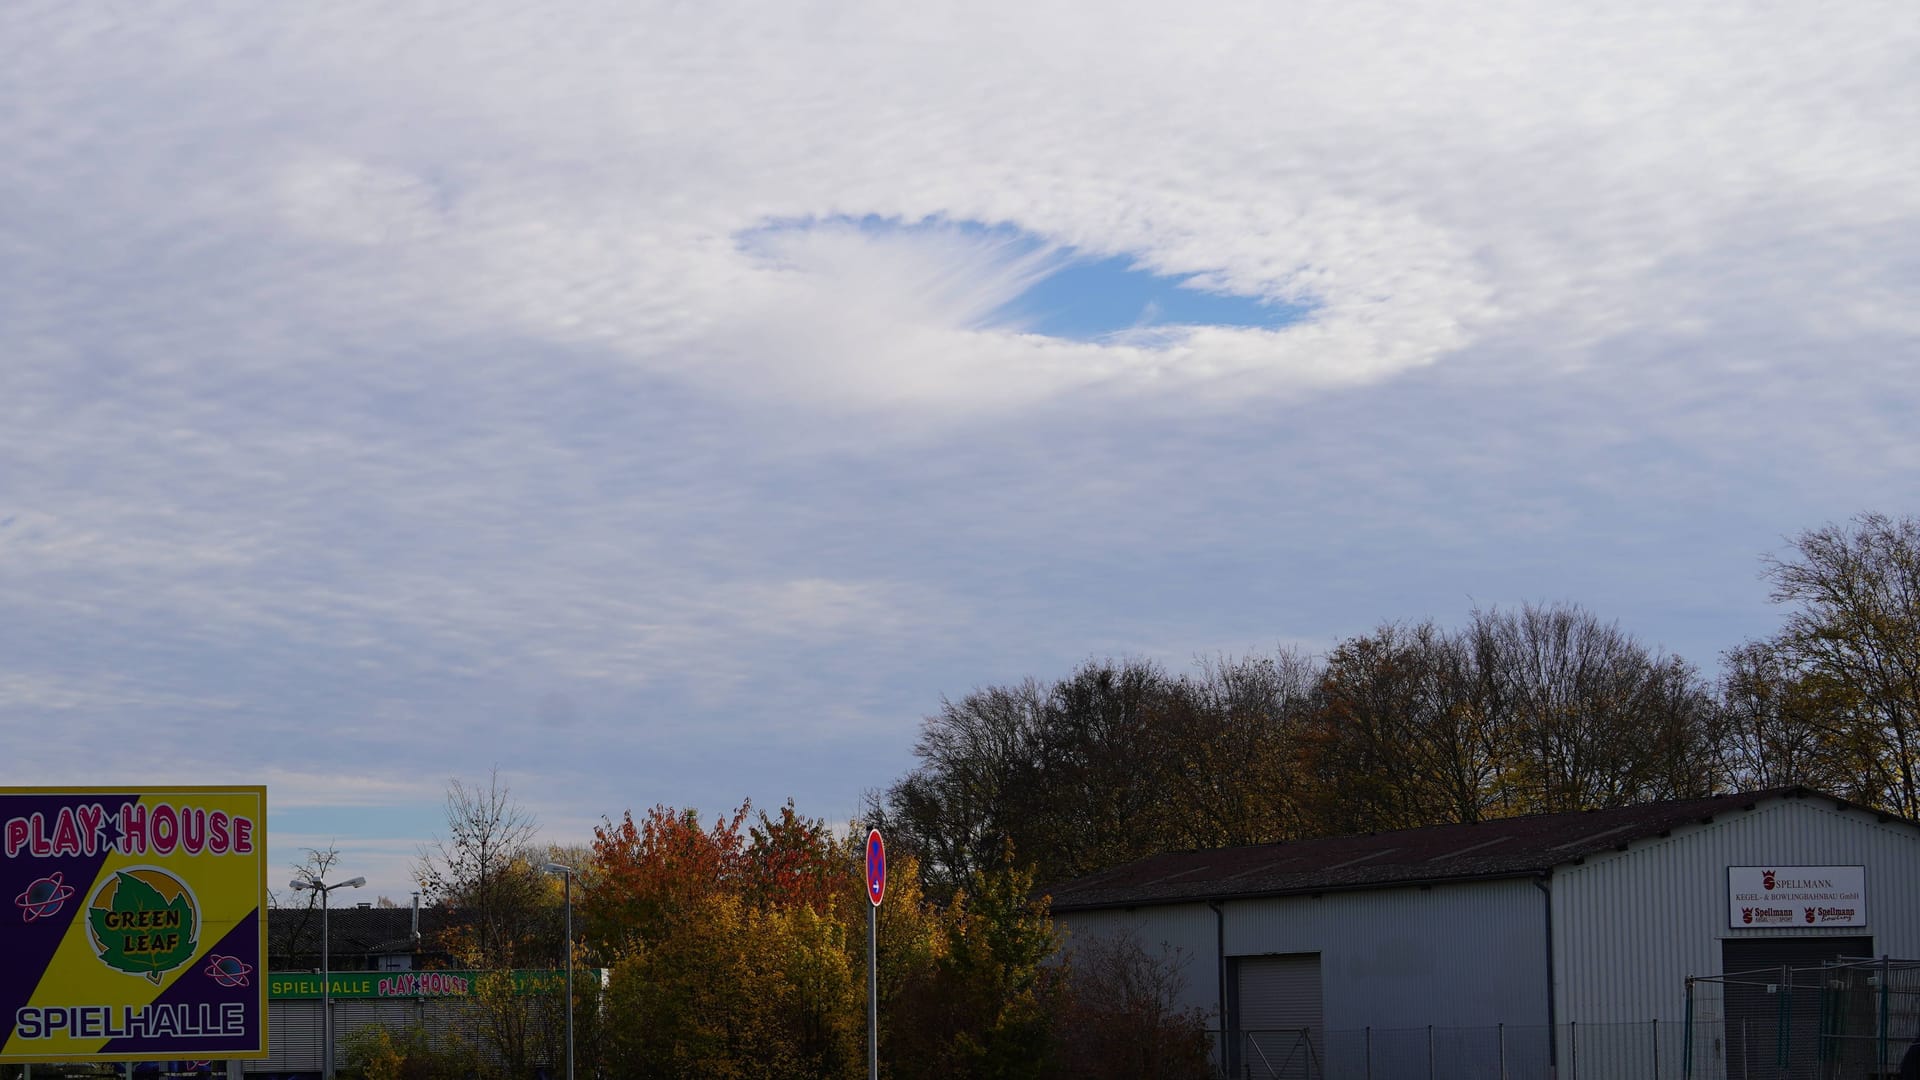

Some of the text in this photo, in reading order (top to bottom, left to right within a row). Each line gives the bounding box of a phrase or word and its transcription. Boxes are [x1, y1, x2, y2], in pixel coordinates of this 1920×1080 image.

[7, 802, 253, 857] PLAY HOUSE
[1776, 879, 1832, 889] SPELLMANN
[1839, 892, 1859, 901] GmbH
[104, 910, 181, 930] GREEN
[1755, 907, 1793, 918] Spellmann
[1817, 907, 1855, 917] Spellmann
[122, 934, 181, 955] LEAF
[378, 973, 414, 996] PLAY
[420, 972, 468, 996] HOUSE
[17, 1002, 244, 1039] SPIELHALLE
